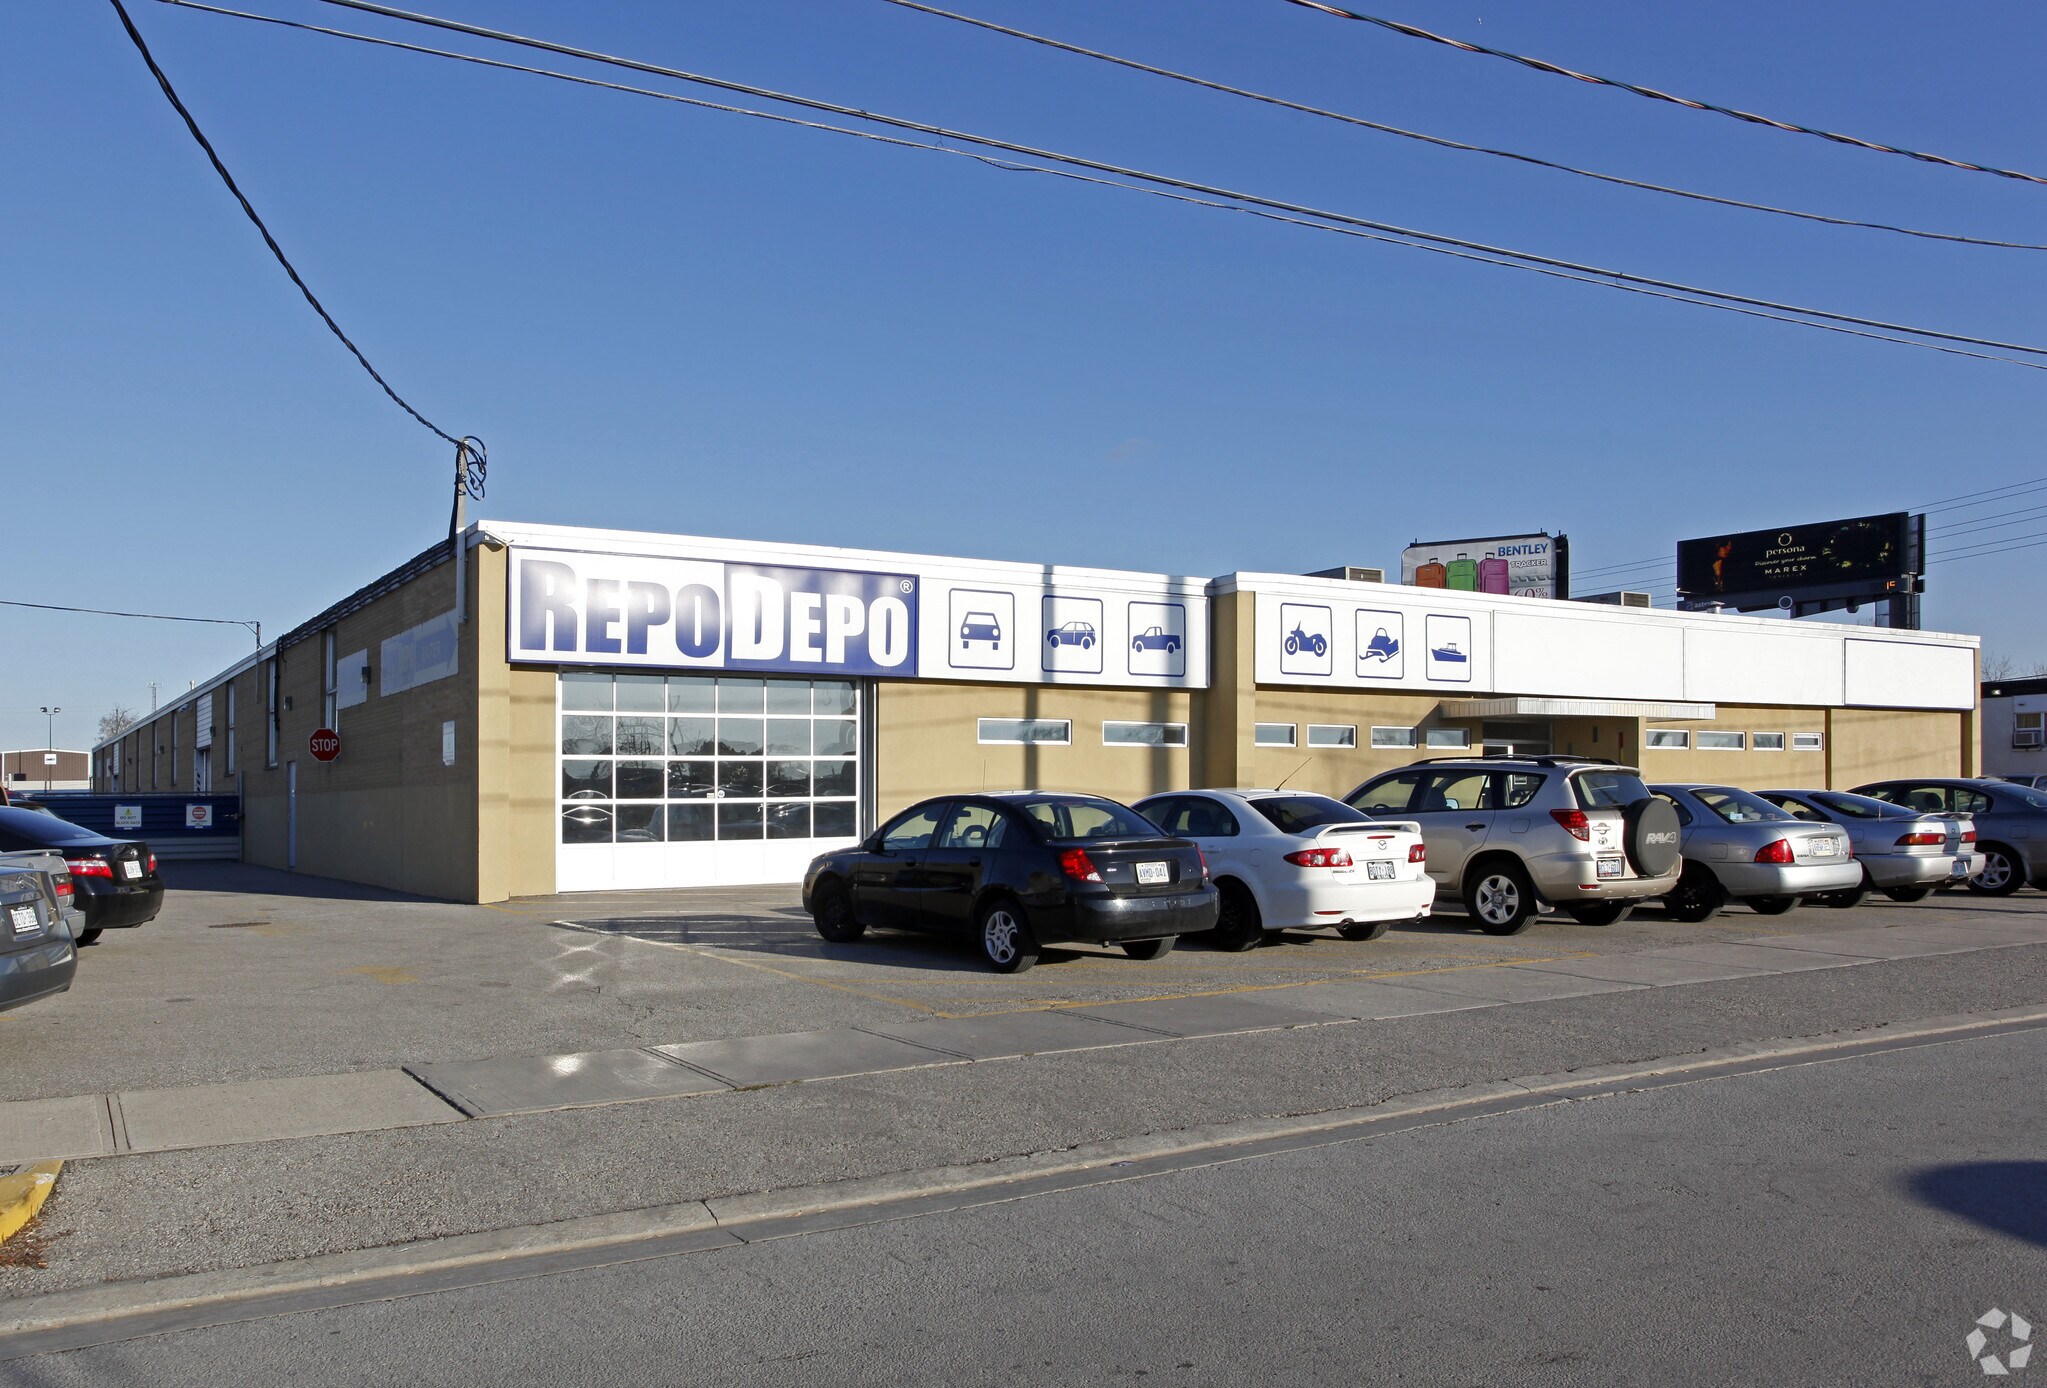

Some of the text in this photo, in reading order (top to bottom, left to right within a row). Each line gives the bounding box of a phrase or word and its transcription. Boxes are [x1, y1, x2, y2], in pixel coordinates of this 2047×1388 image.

[1498, 543, 1548, 557] BENTLEY
[1765, 545, 1805, 558] persona
[1510, 559, 1548, 569] TRACKER
[1764, 565, 1807, 574] MAREX
[311, 739, 338, 751] STOP
[1645, 832, 1677, 844] RAV4
